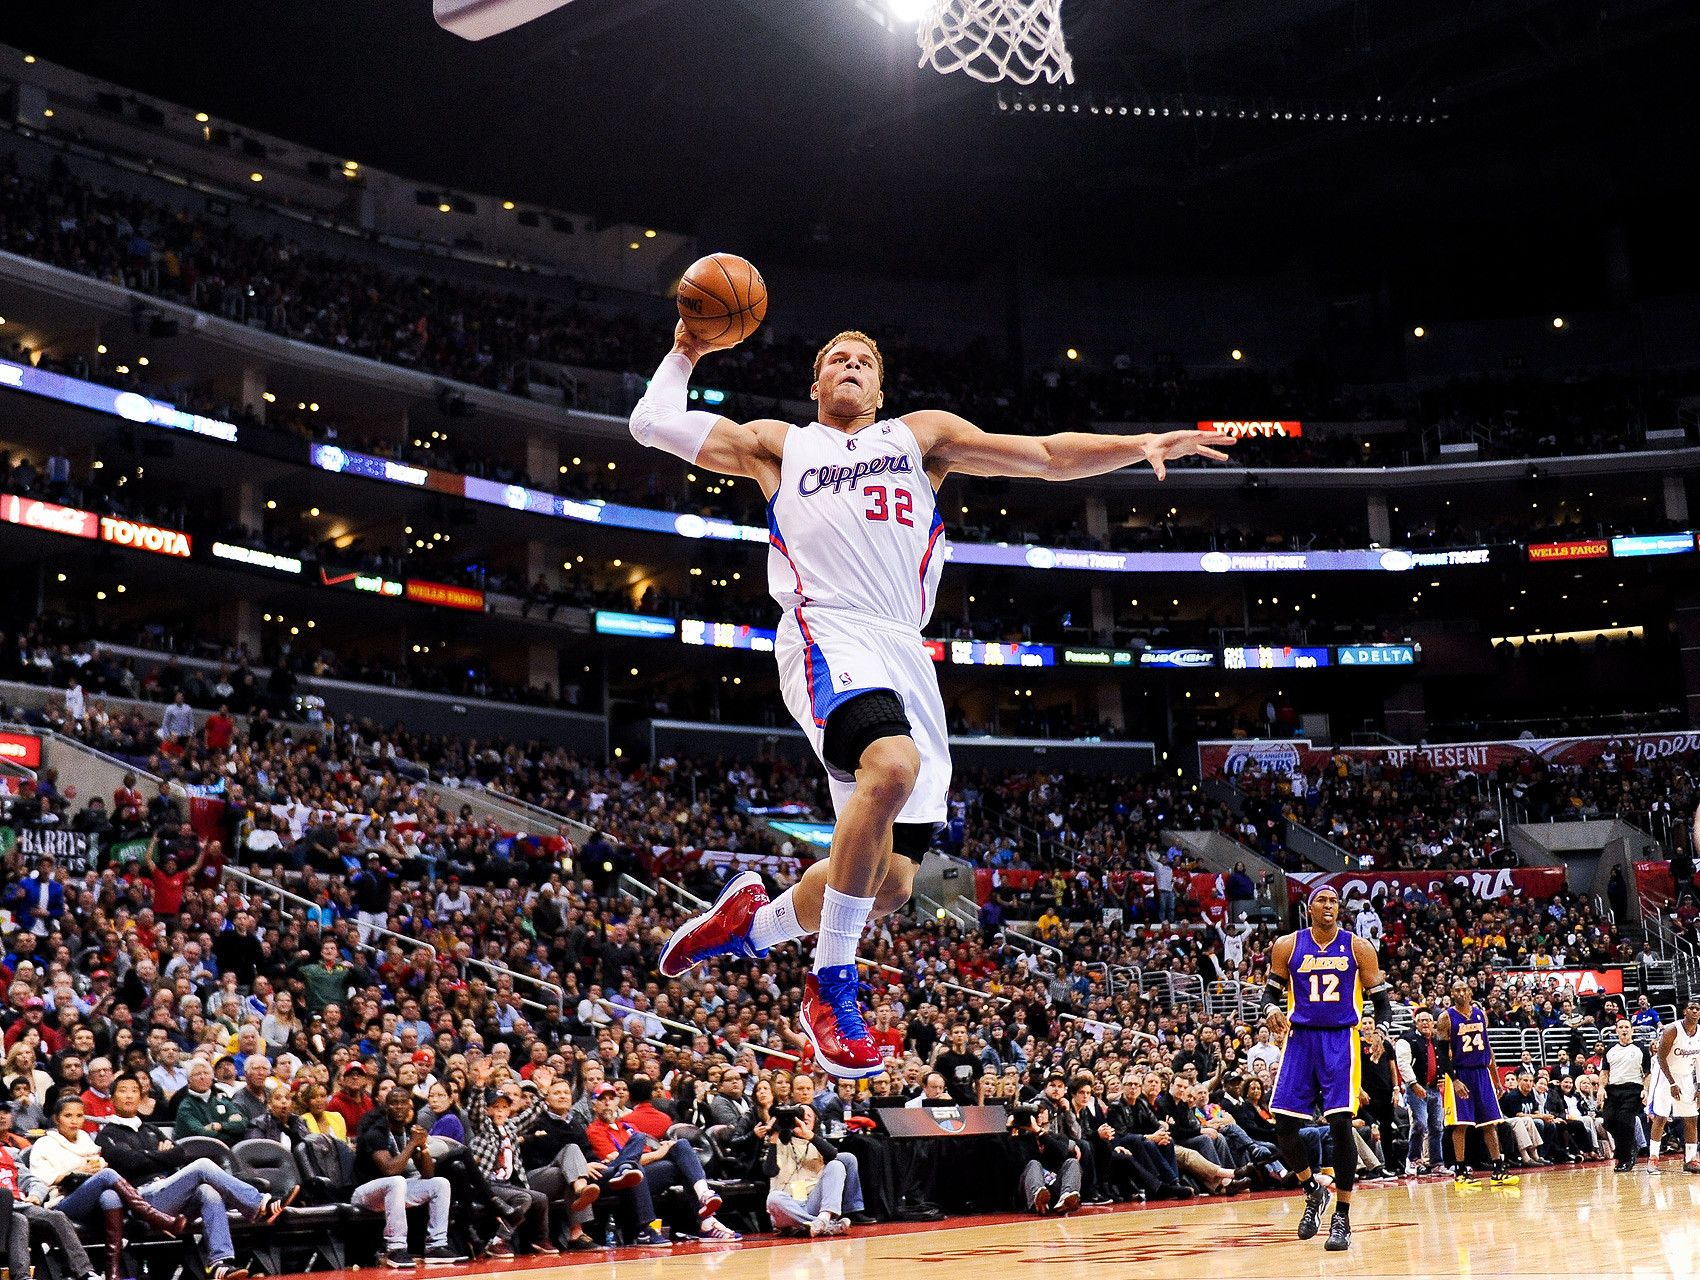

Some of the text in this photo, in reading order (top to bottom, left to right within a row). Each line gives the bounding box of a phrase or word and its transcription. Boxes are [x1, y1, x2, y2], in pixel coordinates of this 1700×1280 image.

[798, 454, 914, 497] Clippers
[863, 485, 915, 529] 32
[101, 517, 191, 557] TOYOTA
[1530, 545, 1608, 559] WELLS FARGO
[1141, 653, 1213, 664] BUD LIGHT
[1357, 649, 1414, 663] DELTA
[1308, 973, 1341, 1003] 12
[1462, 1033, 1485, 1053] 24
